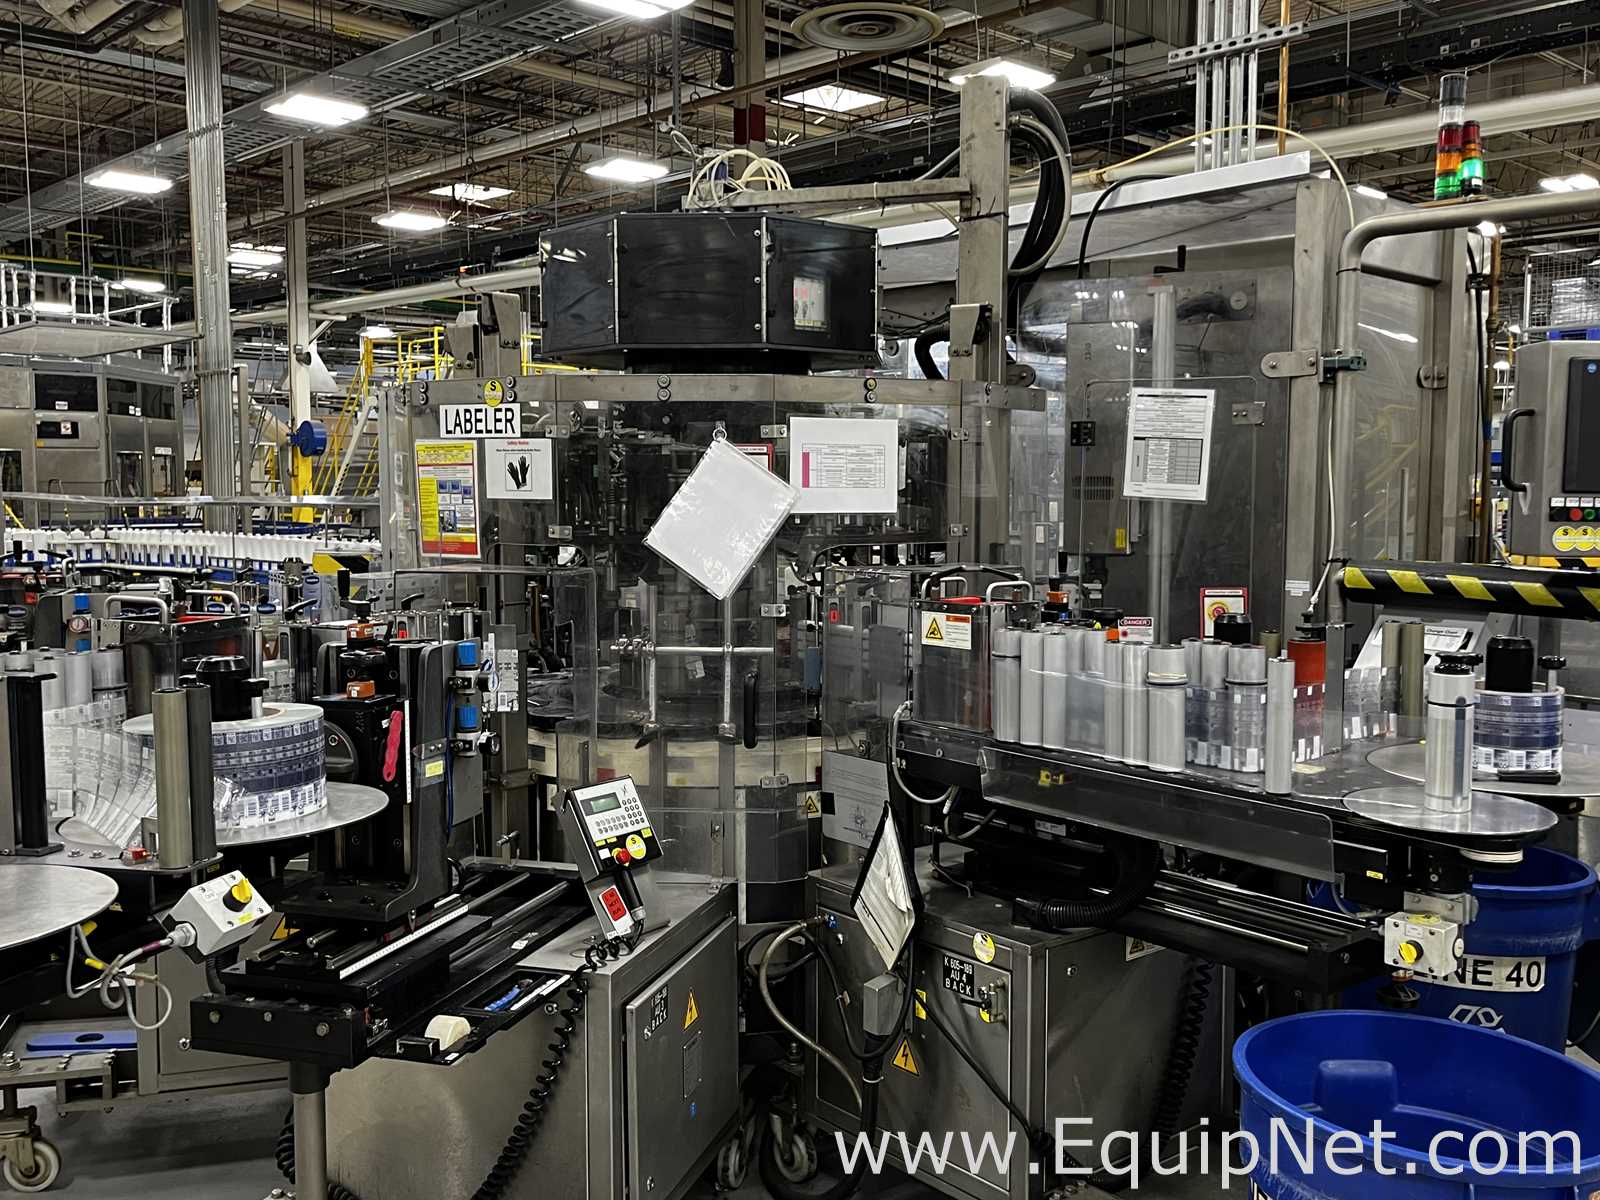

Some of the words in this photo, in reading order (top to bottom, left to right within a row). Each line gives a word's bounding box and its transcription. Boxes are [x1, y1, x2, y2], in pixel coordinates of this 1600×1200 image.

[445, 408, 515, 434] LABELER
[950, 969, 960, 981] AU
[962, 973, 967, 983] 4
[1413, 958, 1494, 987] NE
[1506, 961, 1542, 988] 40
[945, 978, 971, 995] BACK
[651, 1008, 667, 1030] BACK
